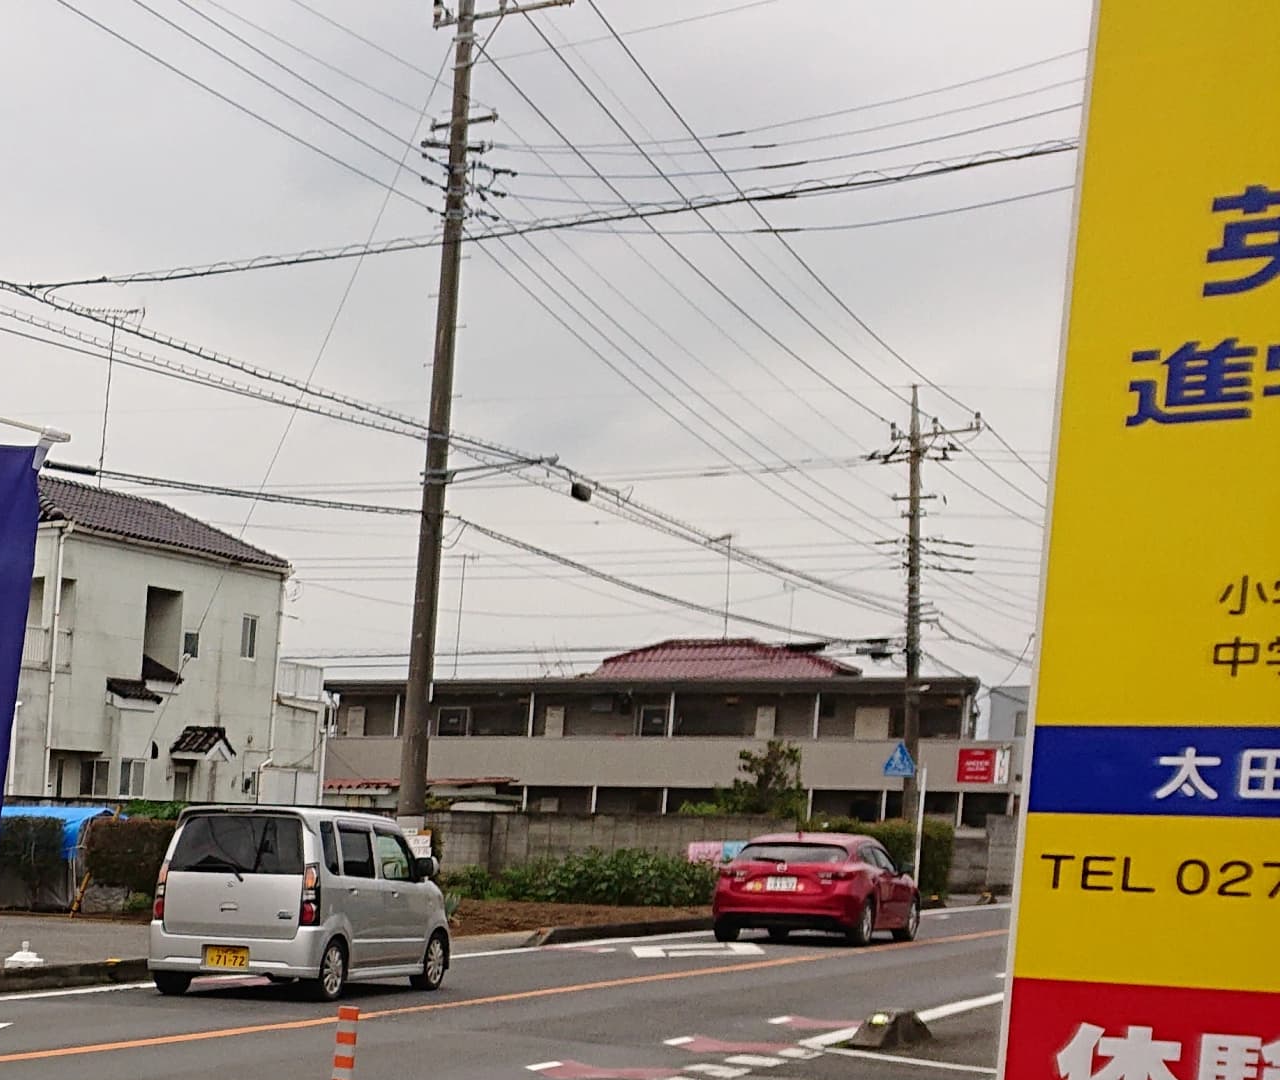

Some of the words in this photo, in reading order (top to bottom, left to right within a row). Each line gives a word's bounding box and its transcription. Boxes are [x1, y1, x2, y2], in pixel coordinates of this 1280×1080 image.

[1125, 337, 1280, 426] 進
[1219, 574, 1280, 616] 小
[1040, 854, 1156, 893] TEL
